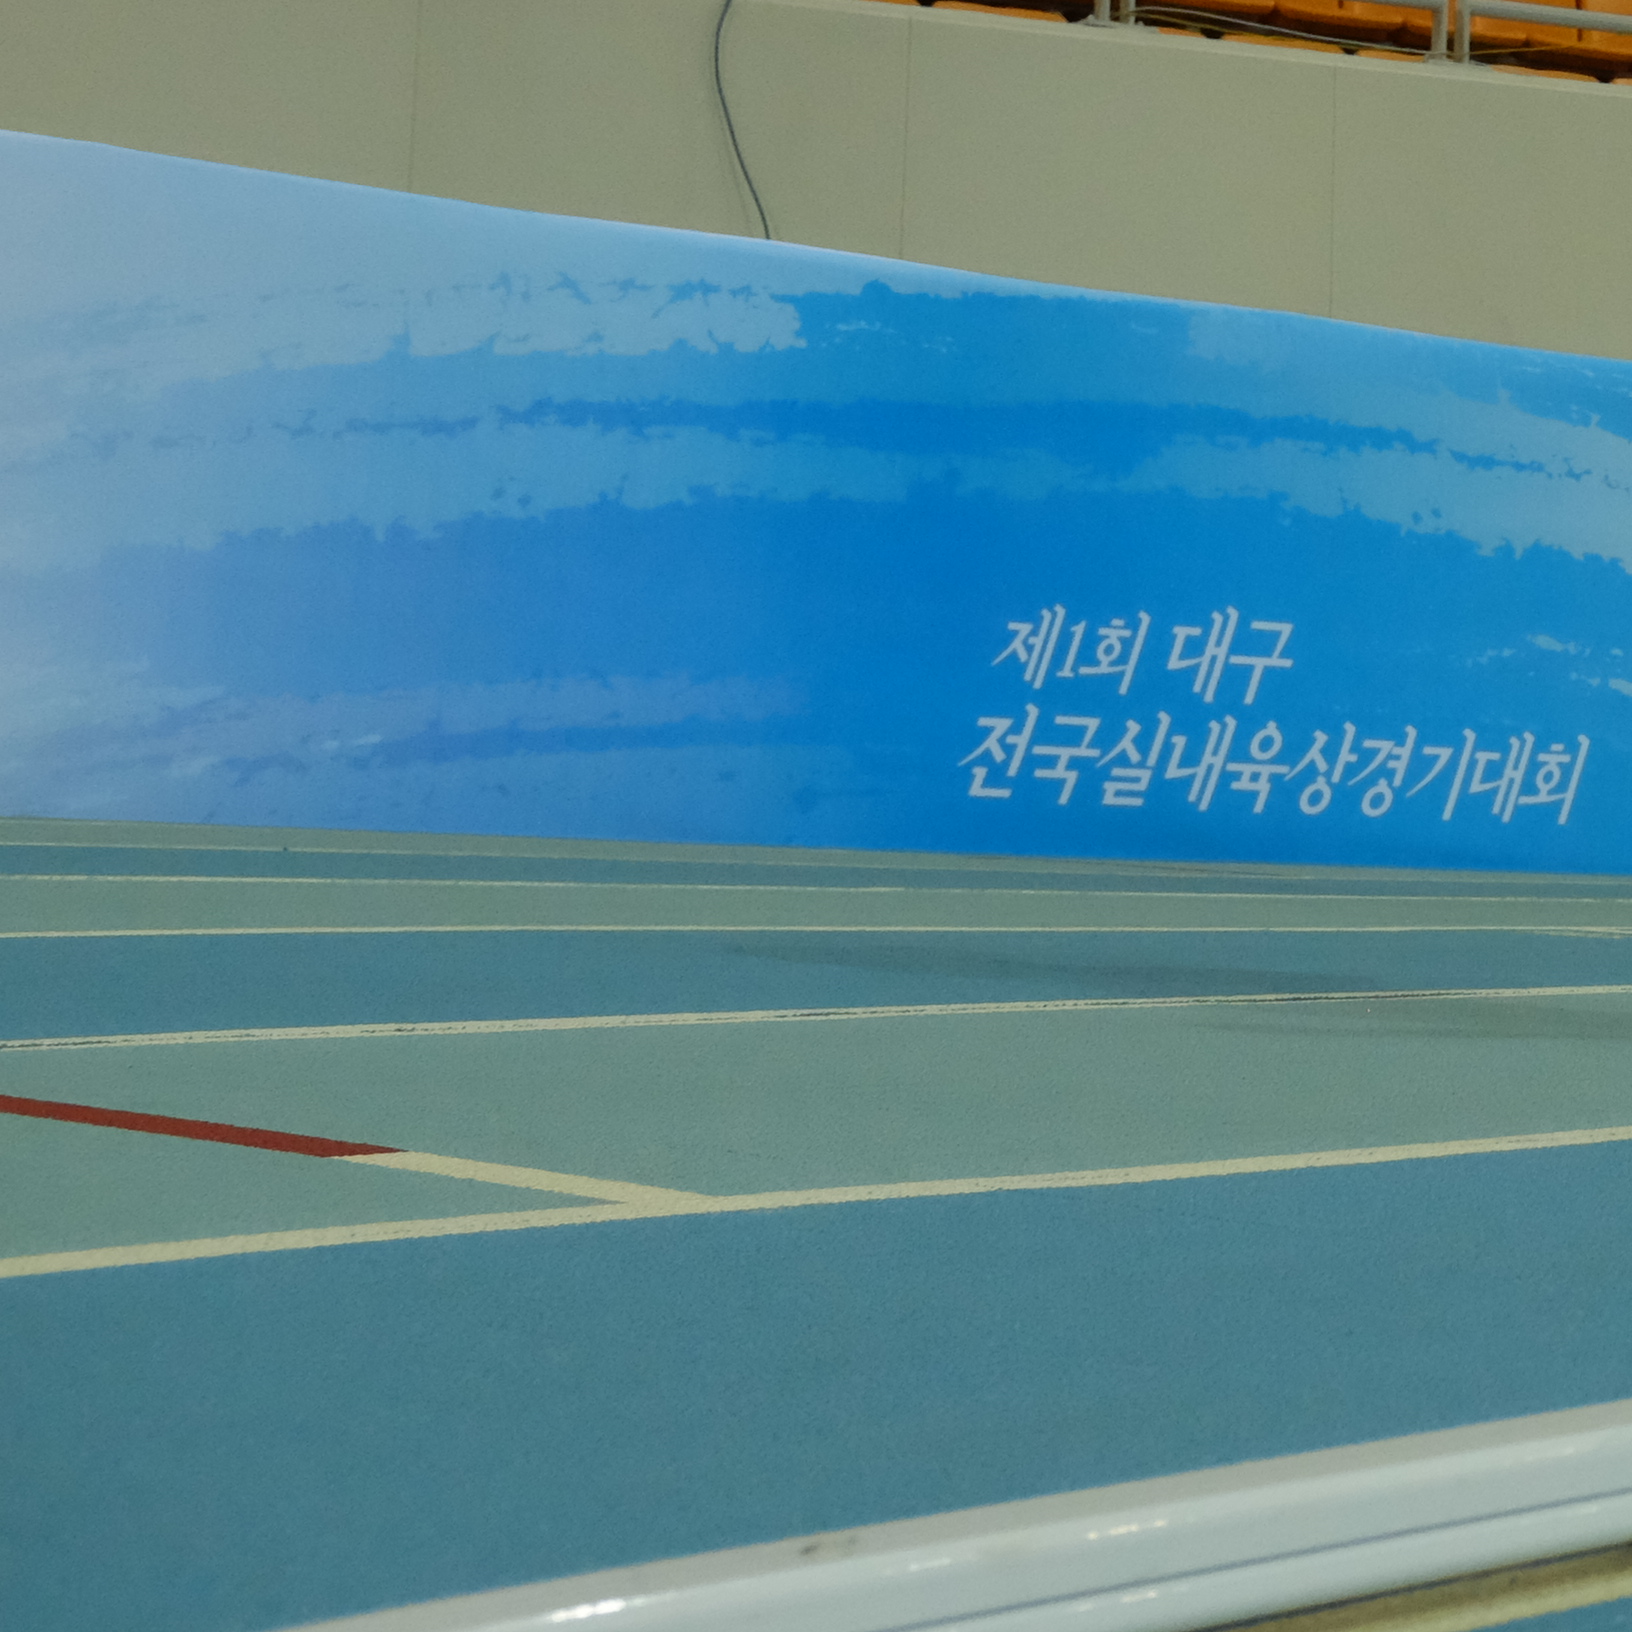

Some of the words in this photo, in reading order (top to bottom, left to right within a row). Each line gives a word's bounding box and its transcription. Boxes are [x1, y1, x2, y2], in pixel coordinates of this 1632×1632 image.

[990, 603, 1151, 696] 제1회
[1166, 604, 1295, 706] 대구
[957, 702, 1591, 825] 전국실내육상경기대회
